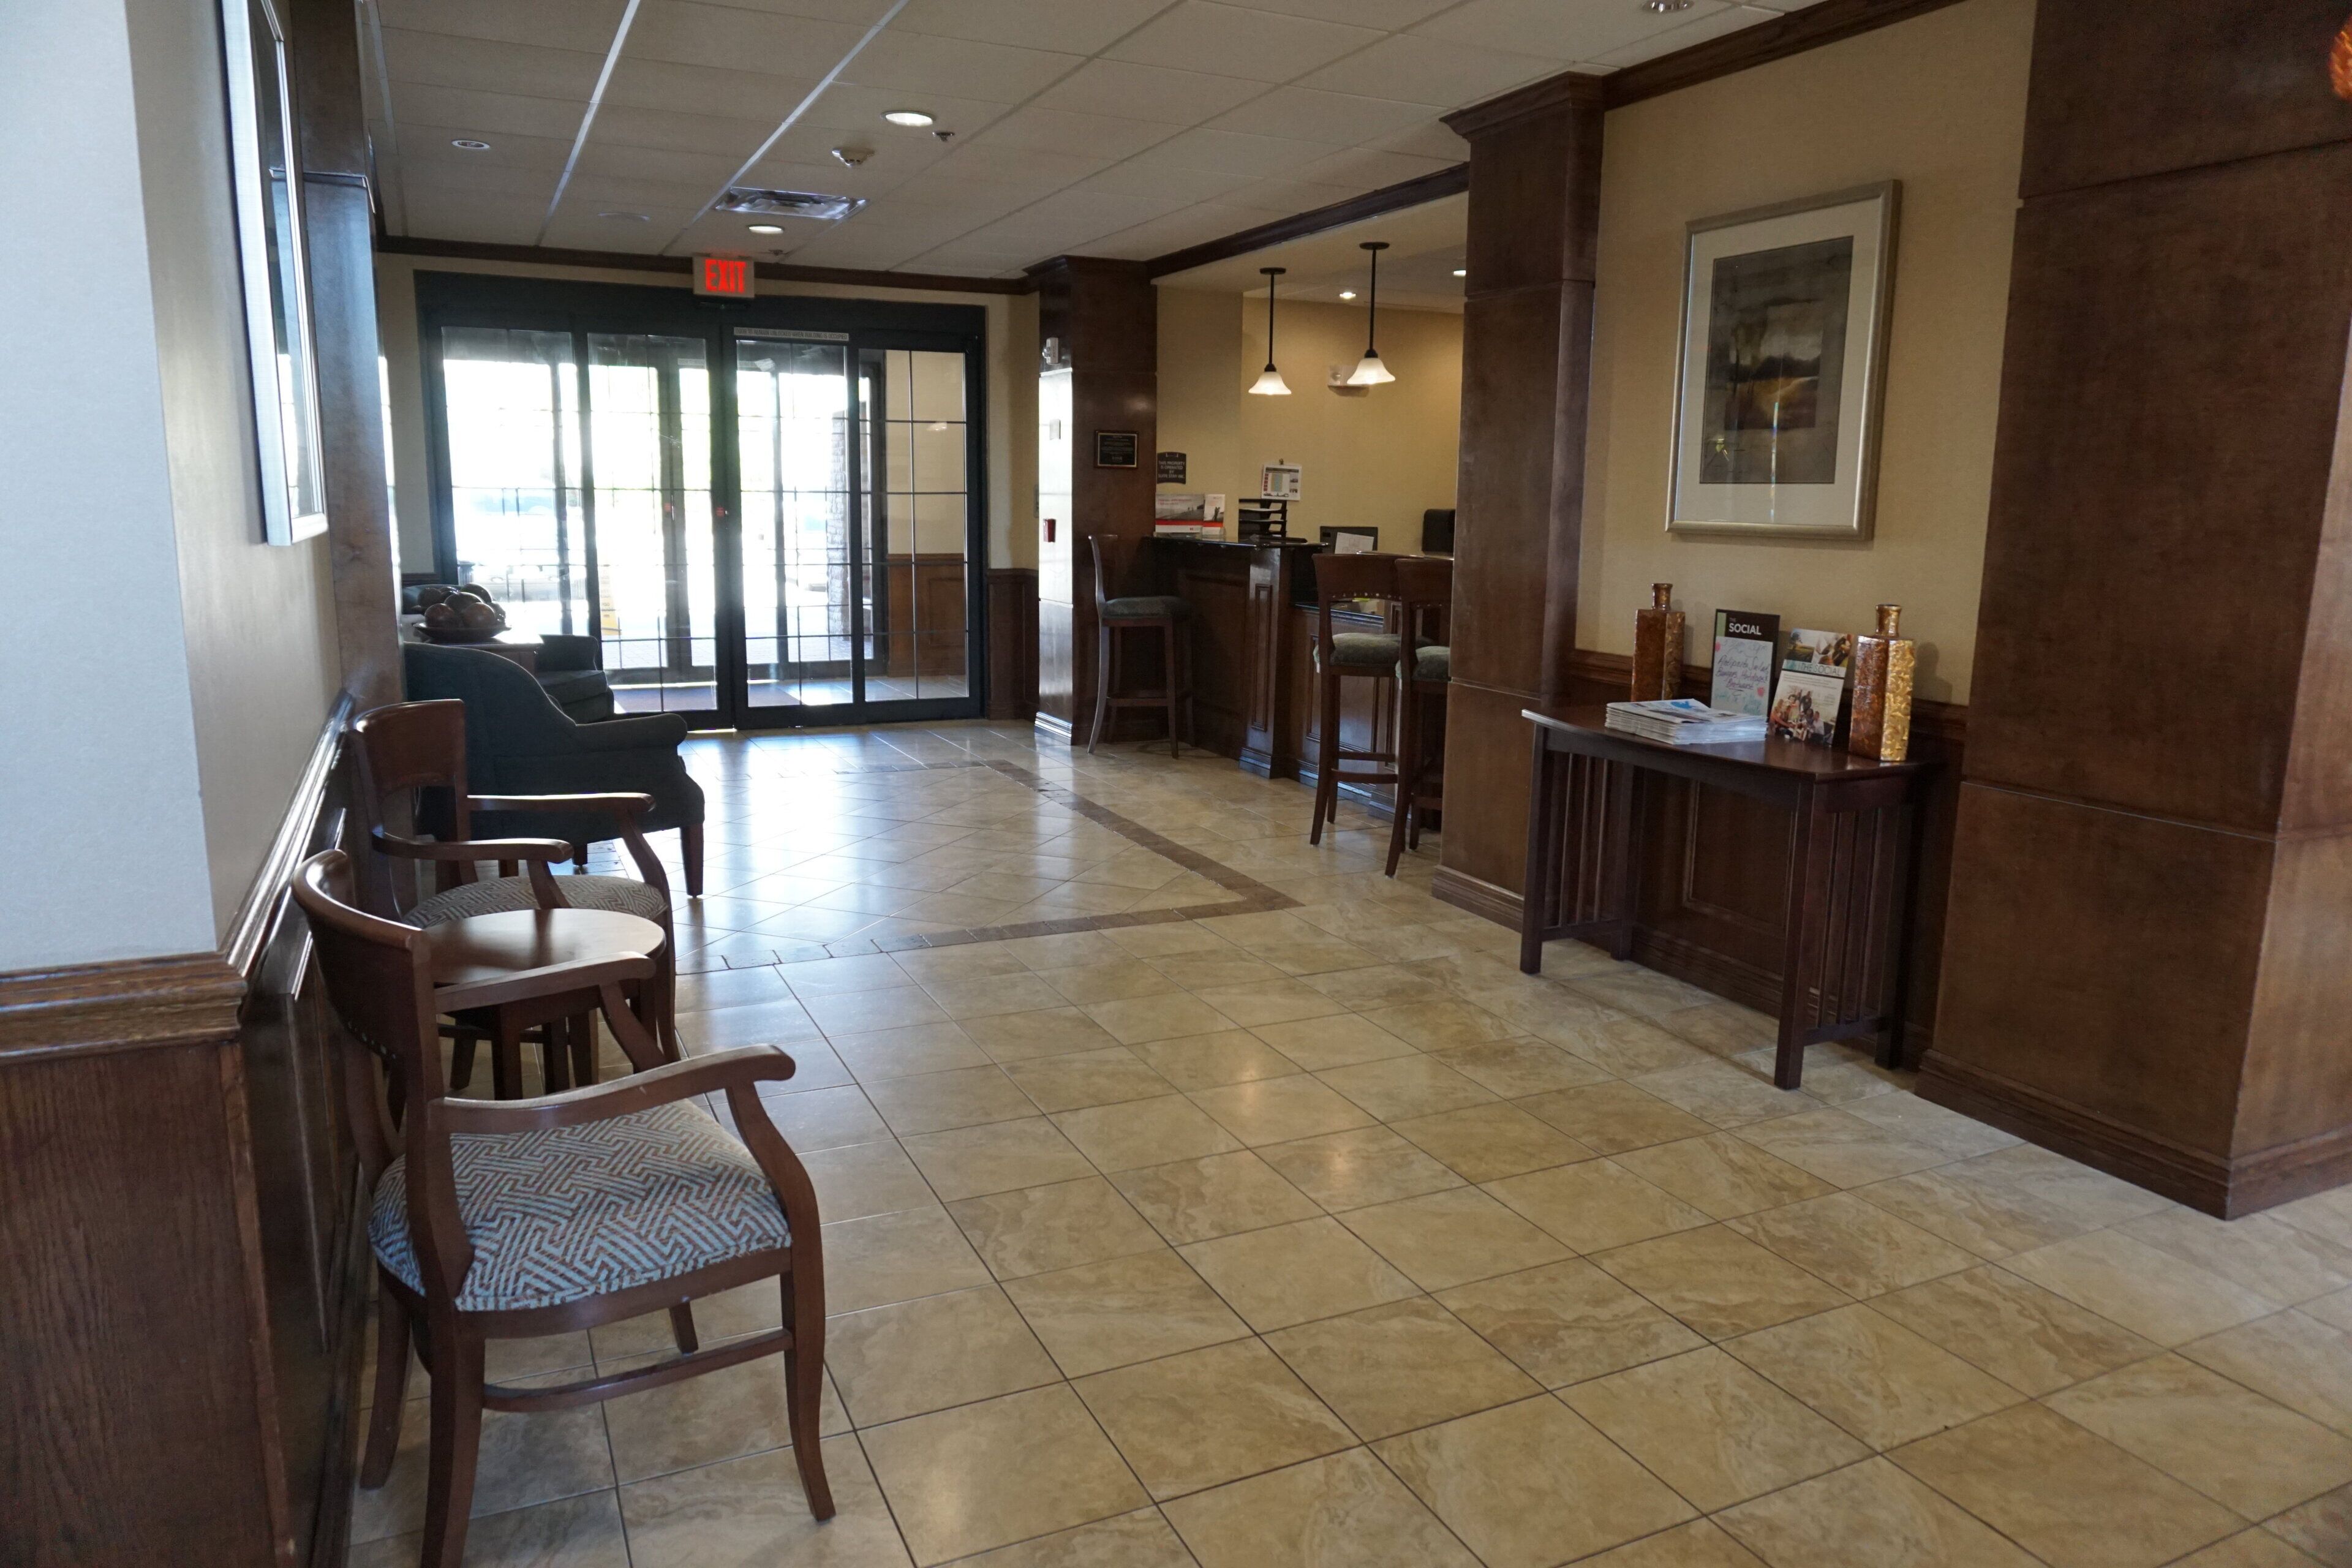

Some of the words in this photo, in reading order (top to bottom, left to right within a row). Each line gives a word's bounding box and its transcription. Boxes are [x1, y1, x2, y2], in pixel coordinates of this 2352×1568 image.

[705, 259, 746, 293] EXIT
[1728, 622, 1762, 635] SOCIAL
[1802, 663, 1812, 673] THE
[1814, 663, 1841, 676] SOCIAL
